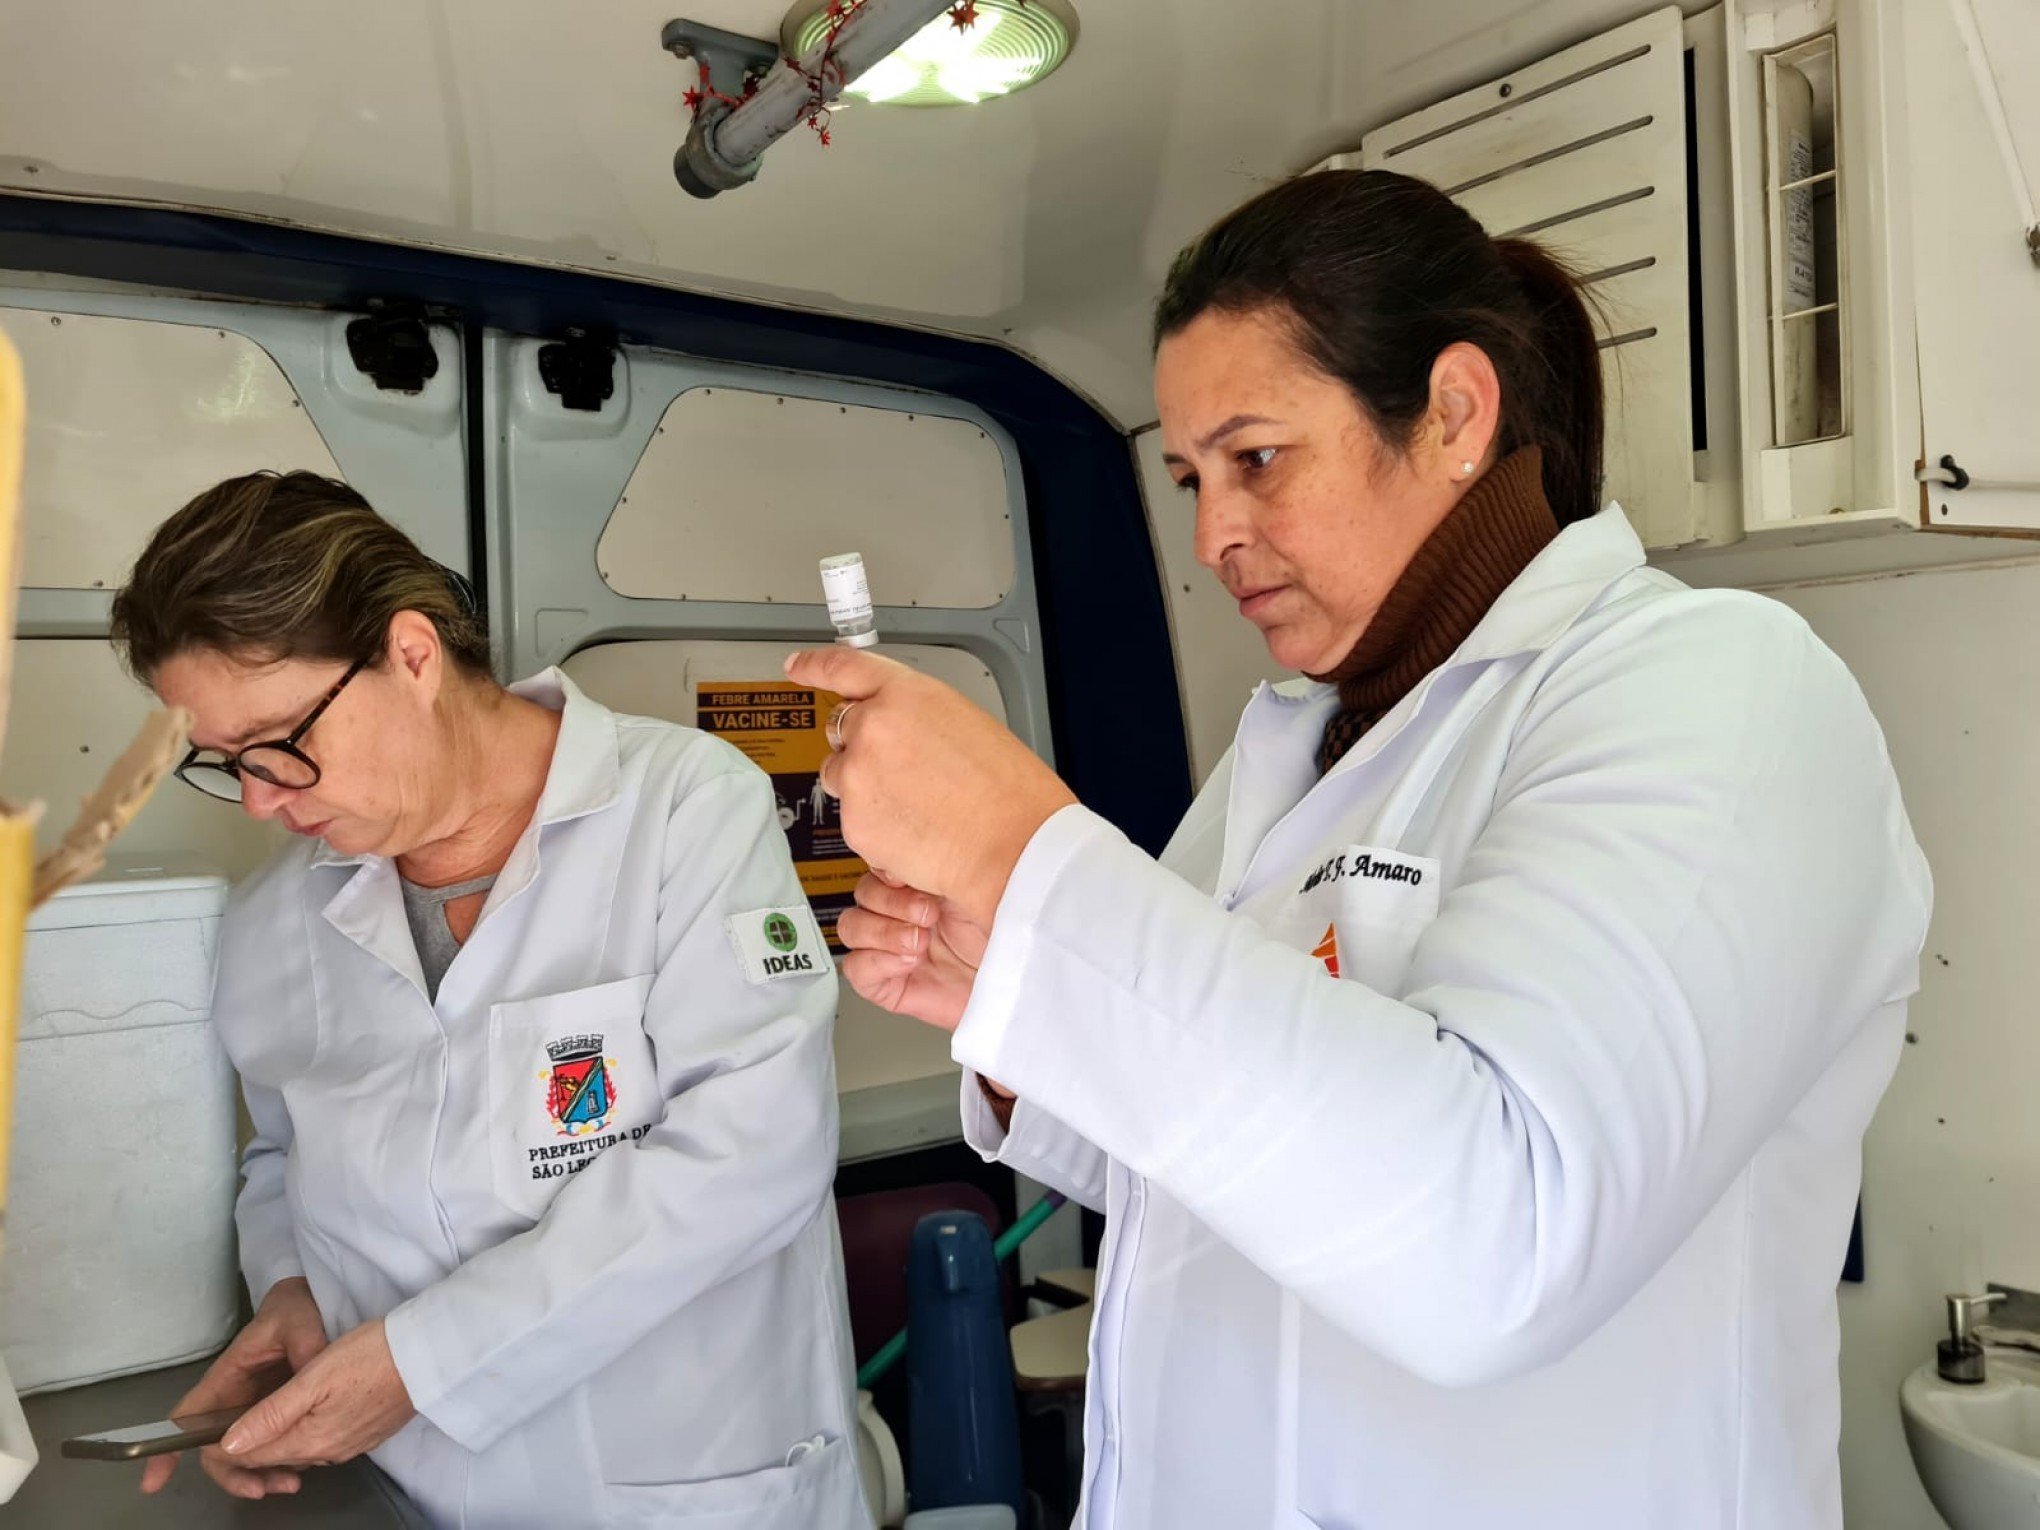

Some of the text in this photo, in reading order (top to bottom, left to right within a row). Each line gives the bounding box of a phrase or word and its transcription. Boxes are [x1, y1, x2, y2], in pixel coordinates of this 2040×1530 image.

[713, 693, 809, 706] FEBRE AMARELA
[713, 711, 812, 729] VACINE-SE
[1349, 854, 1422, 886] Amaro
[763, 953, 813, 975] IDEAS
[528, 1131, 628, 1161] PREFEITURA
[532, 1162, 564, 1180] SÃO
